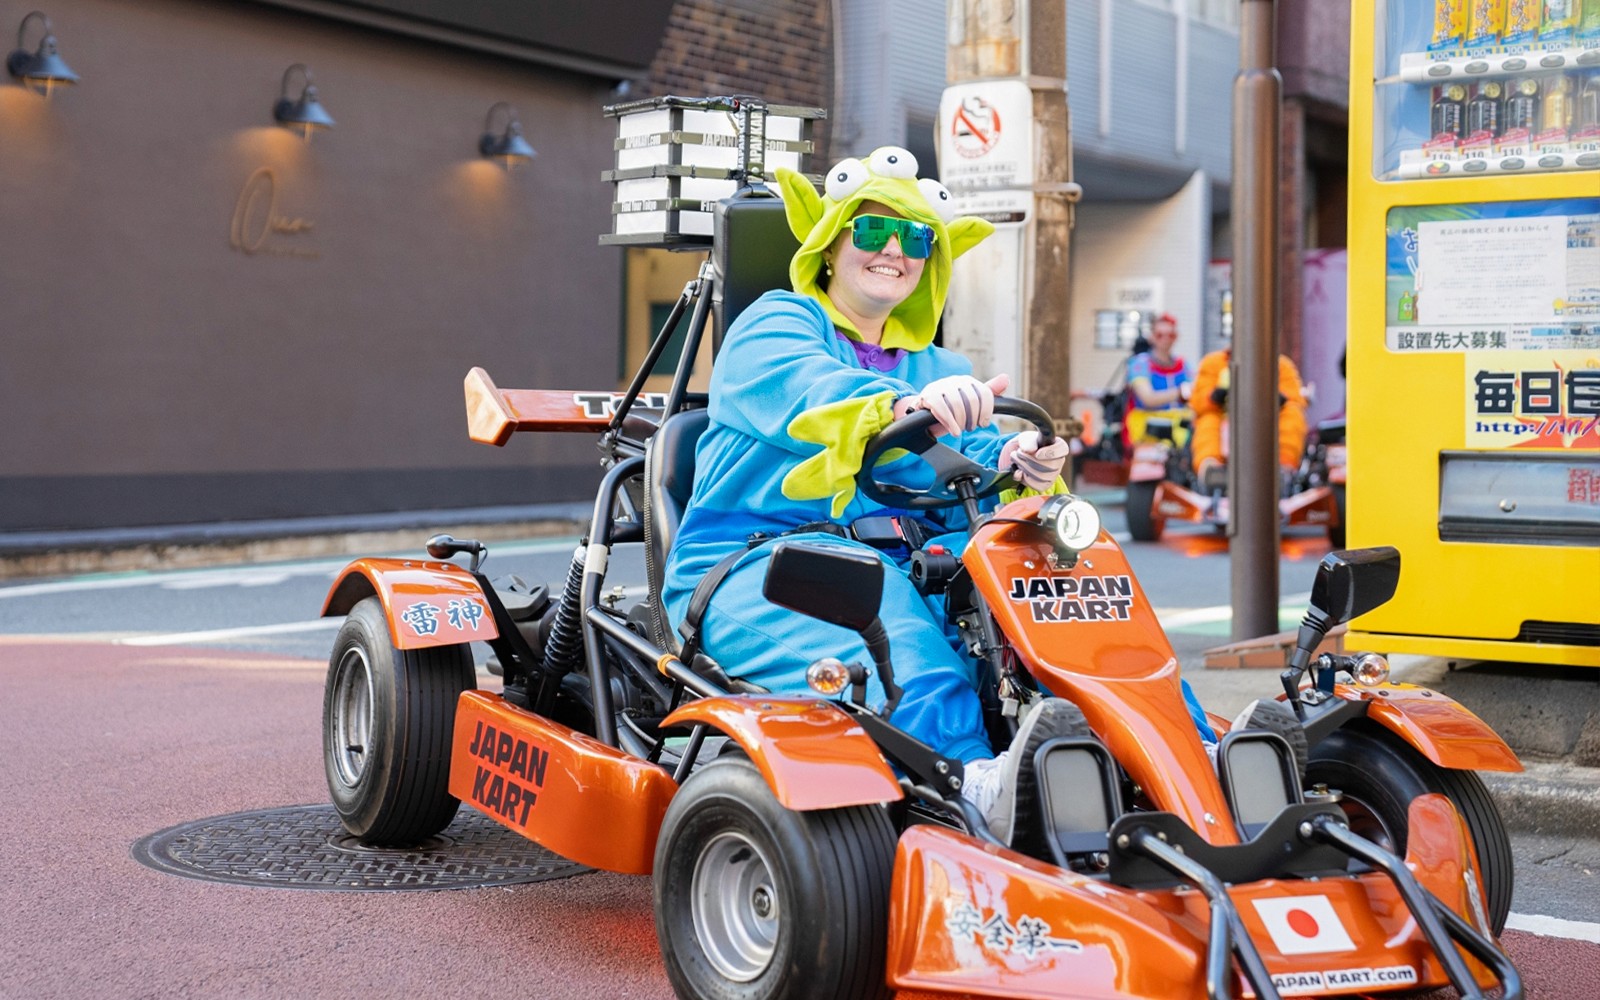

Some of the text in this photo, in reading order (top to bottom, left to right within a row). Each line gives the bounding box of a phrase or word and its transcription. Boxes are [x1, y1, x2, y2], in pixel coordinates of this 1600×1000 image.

[1465, 150, 1484, 159] 110
[1503, 147, 1522, 157] 110
[1398, 331, 1507, 349] 設置先大募集
[1009, 575, 1133, 599] JAPAN
[402, 599, 483, 635] 雷神
[1031, 599, 1132, 622] KART
[469, 721, 549, 787] JAPAN
[472, 766, 538, 827] KART
[947, 903, 1081, 957] 安全第一
[1273, 974, 1321, 990] APAN
